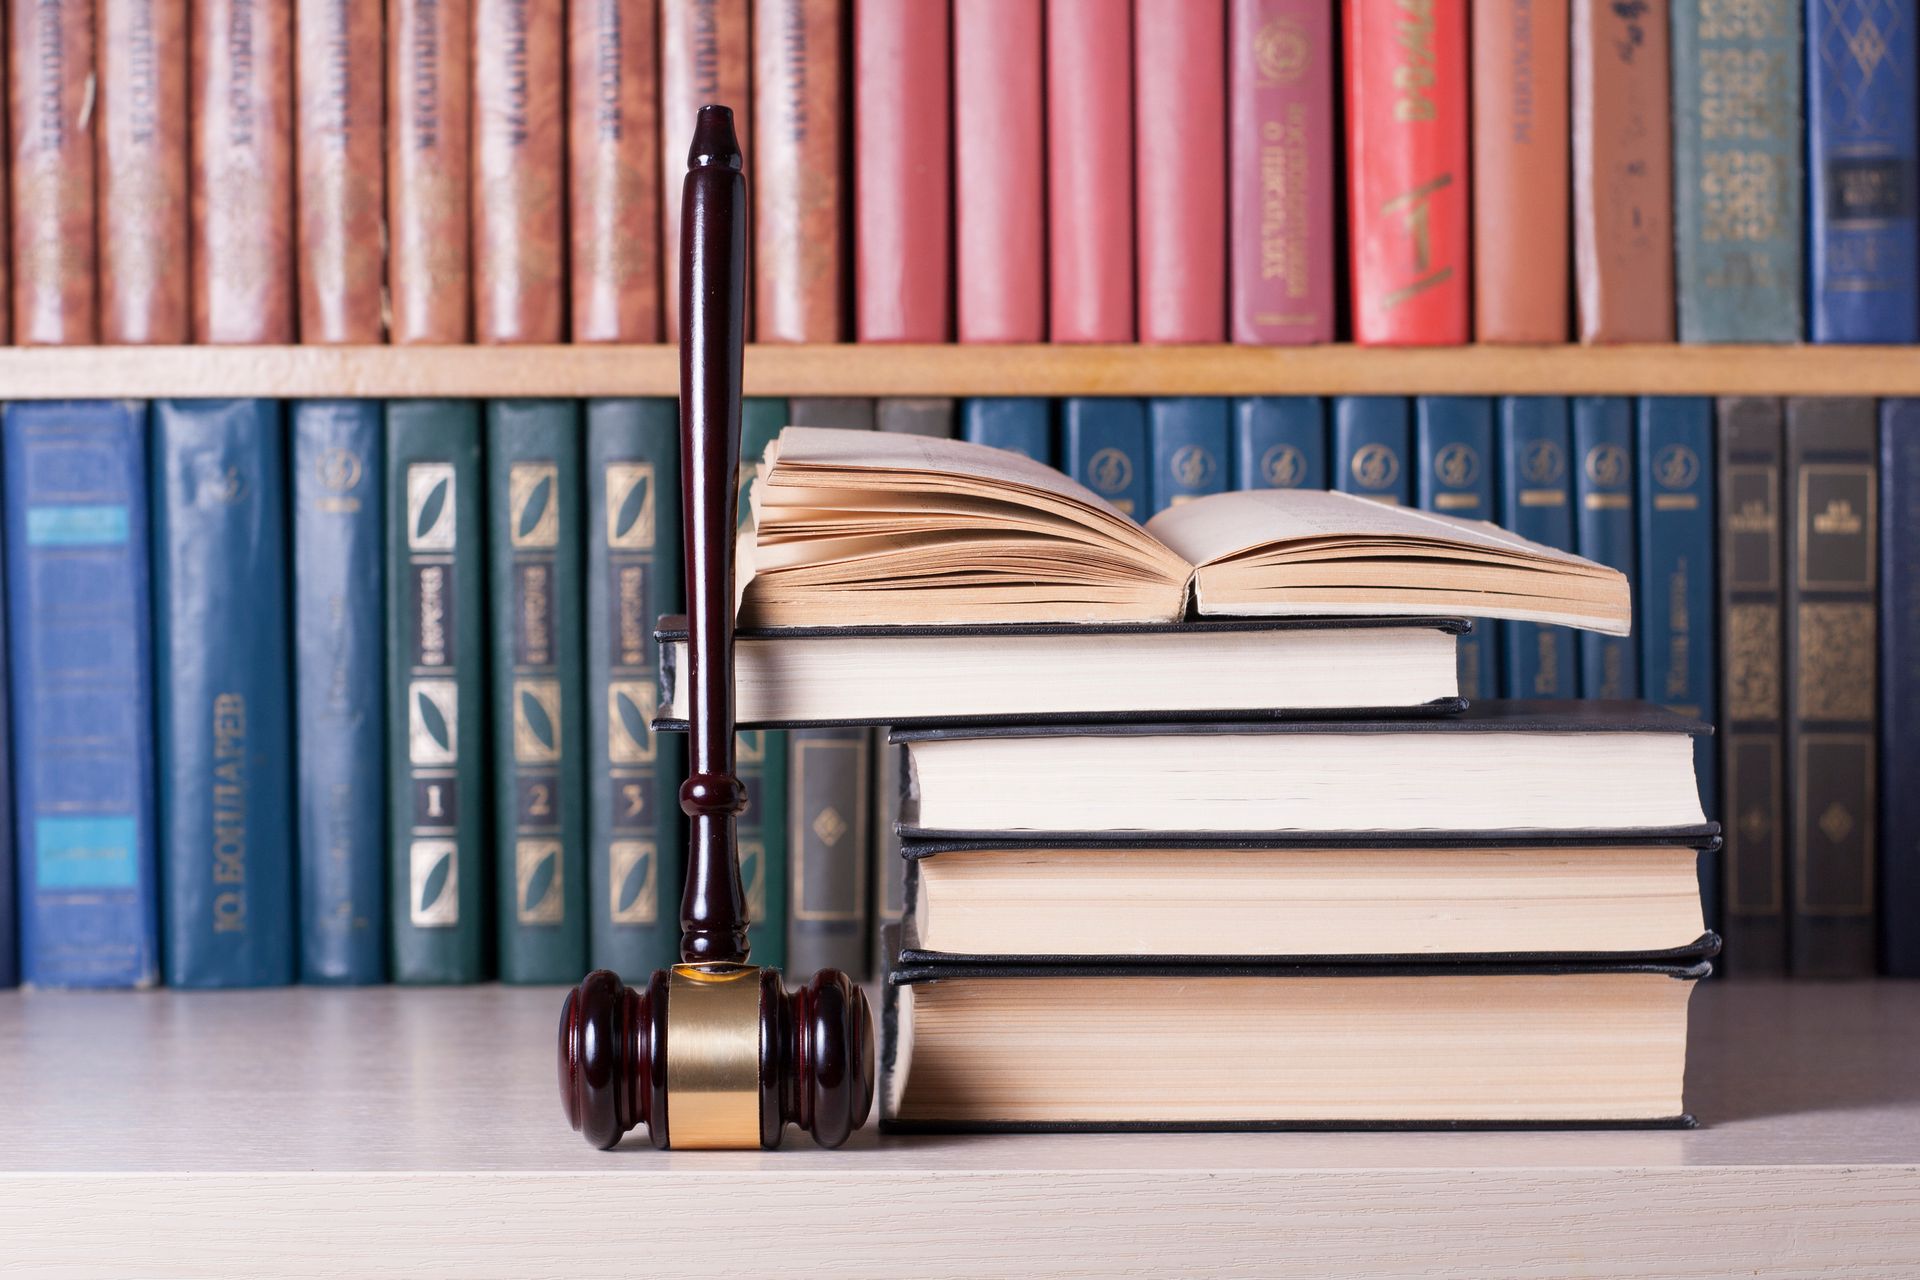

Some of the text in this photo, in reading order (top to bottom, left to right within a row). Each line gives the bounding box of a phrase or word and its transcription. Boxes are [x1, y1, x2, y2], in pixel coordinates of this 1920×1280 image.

[212, 691, 247, 884] БОНДАРЕВ
[426, 785, 444, 818] 1
[527, 784, 550, 816] 2
[622, 783, 644, 818] 3
